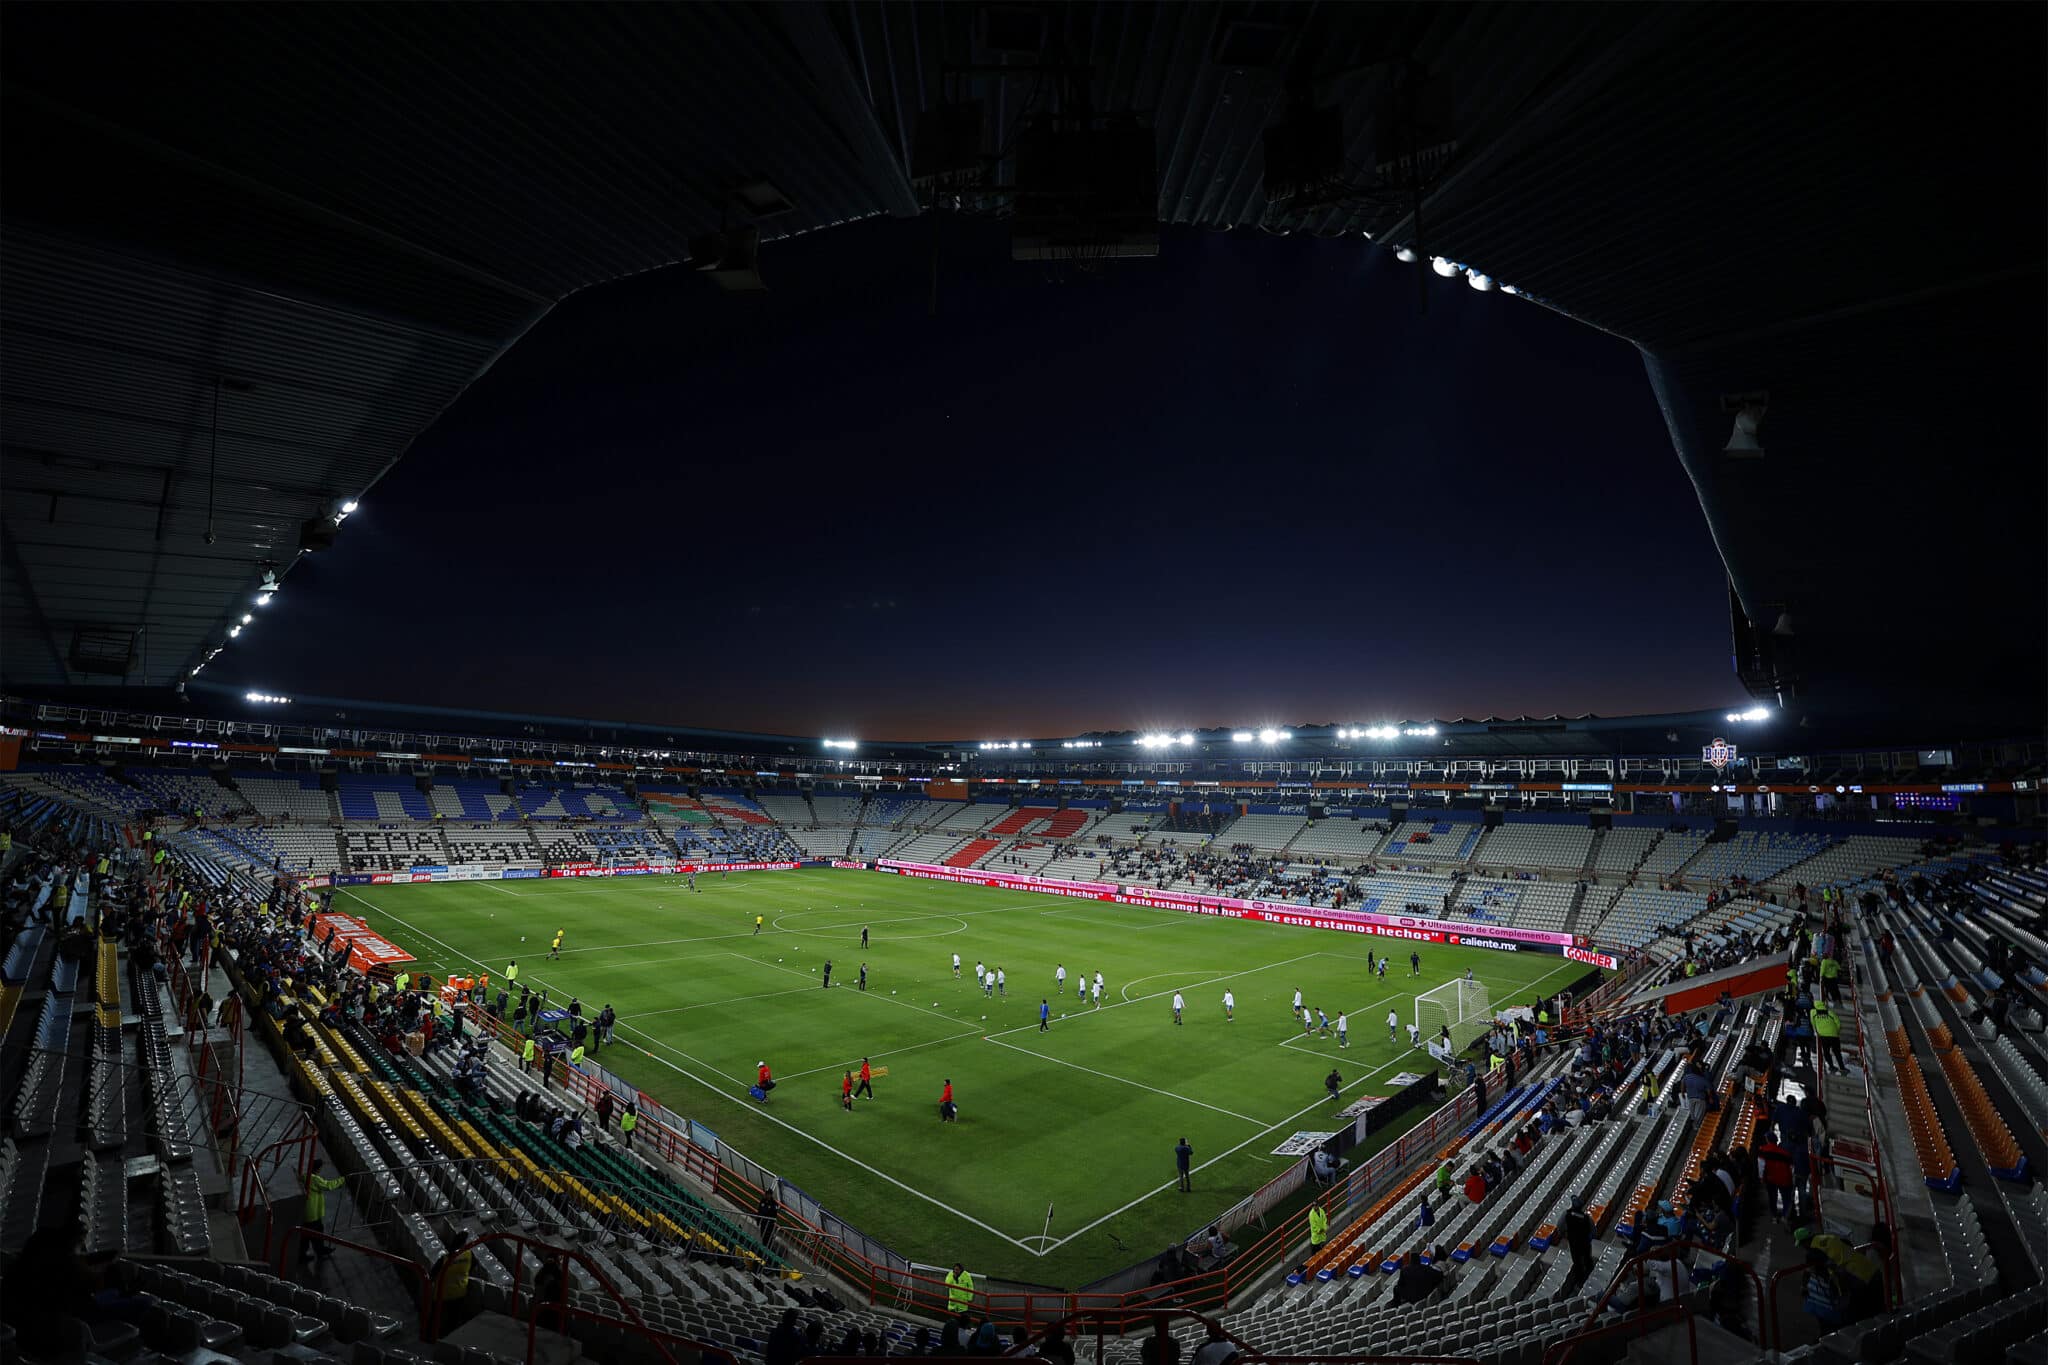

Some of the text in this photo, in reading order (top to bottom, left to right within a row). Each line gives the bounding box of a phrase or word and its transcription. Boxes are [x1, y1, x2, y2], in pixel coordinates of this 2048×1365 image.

[1010, 881, 1028, 891] esto
[1029, 884, 1065, 895] estamos
[1130, 897, 1152, 906] esto
[1154, 900, 1199, 912] estamos
[1274, 904, 1311, 914] Ultrasonido
[1312, 907, 1322, 915] de
[1283, 915, 1311, 926] esto
[1314, 919, 1374, 934] estamos
[1427, 920, 1474, 934] Ultrasonido
[1476, 926, 1487, 935] de
[1489, 927, 1551, 942] Complemento
[1460, 935, 1517, 952] caliente.mx
[1567, 947, 1613, 968] GONHER
